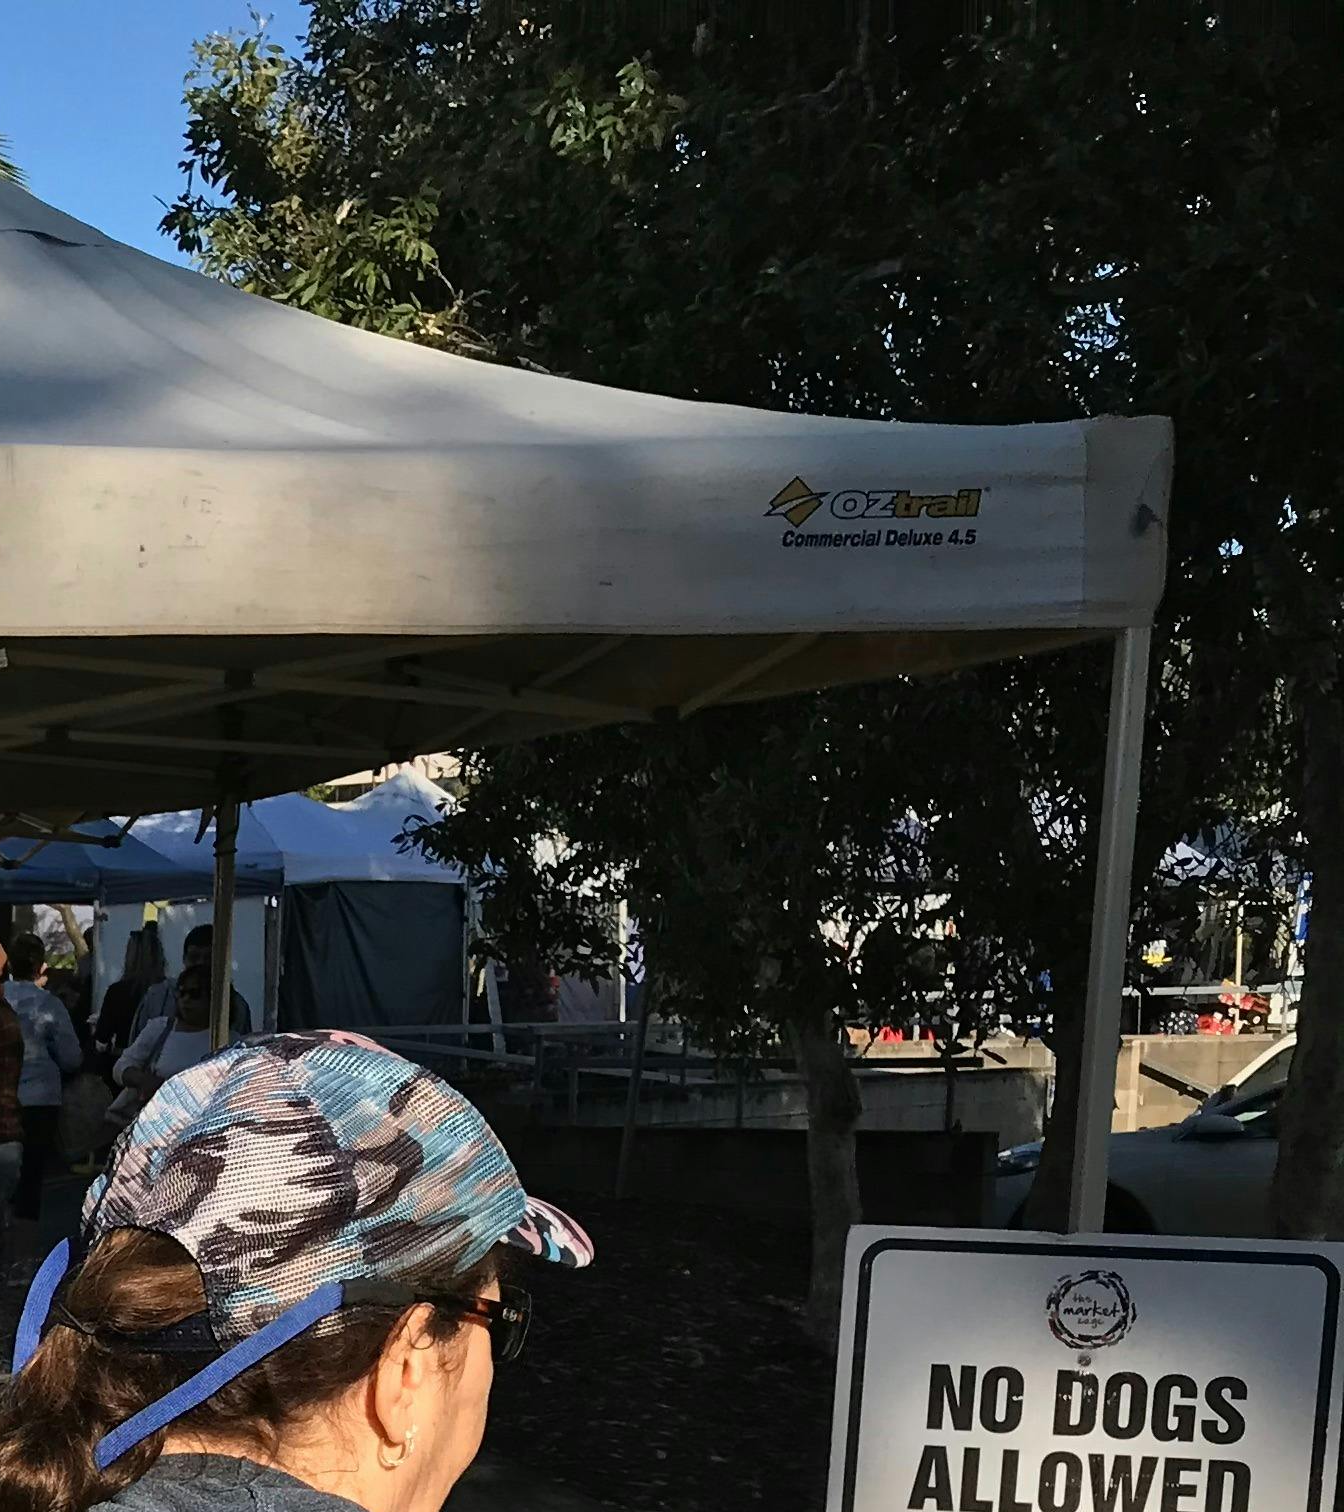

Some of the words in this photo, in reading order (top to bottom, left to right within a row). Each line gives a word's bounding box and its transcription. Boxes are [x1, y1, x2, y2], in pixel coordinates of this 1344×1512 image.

[830, 488, 982, 519] OZtrail
[782, 529, 881, 547] Commercial
[885, 529, 943, 546] Deluxe
[948, 529, 977, 545] 4.5
[1063, 1300, 1120, 1317] market
[926, 1363, 1025, 1434] NO
[1052, 1369, 1248, 1445] DOGS
